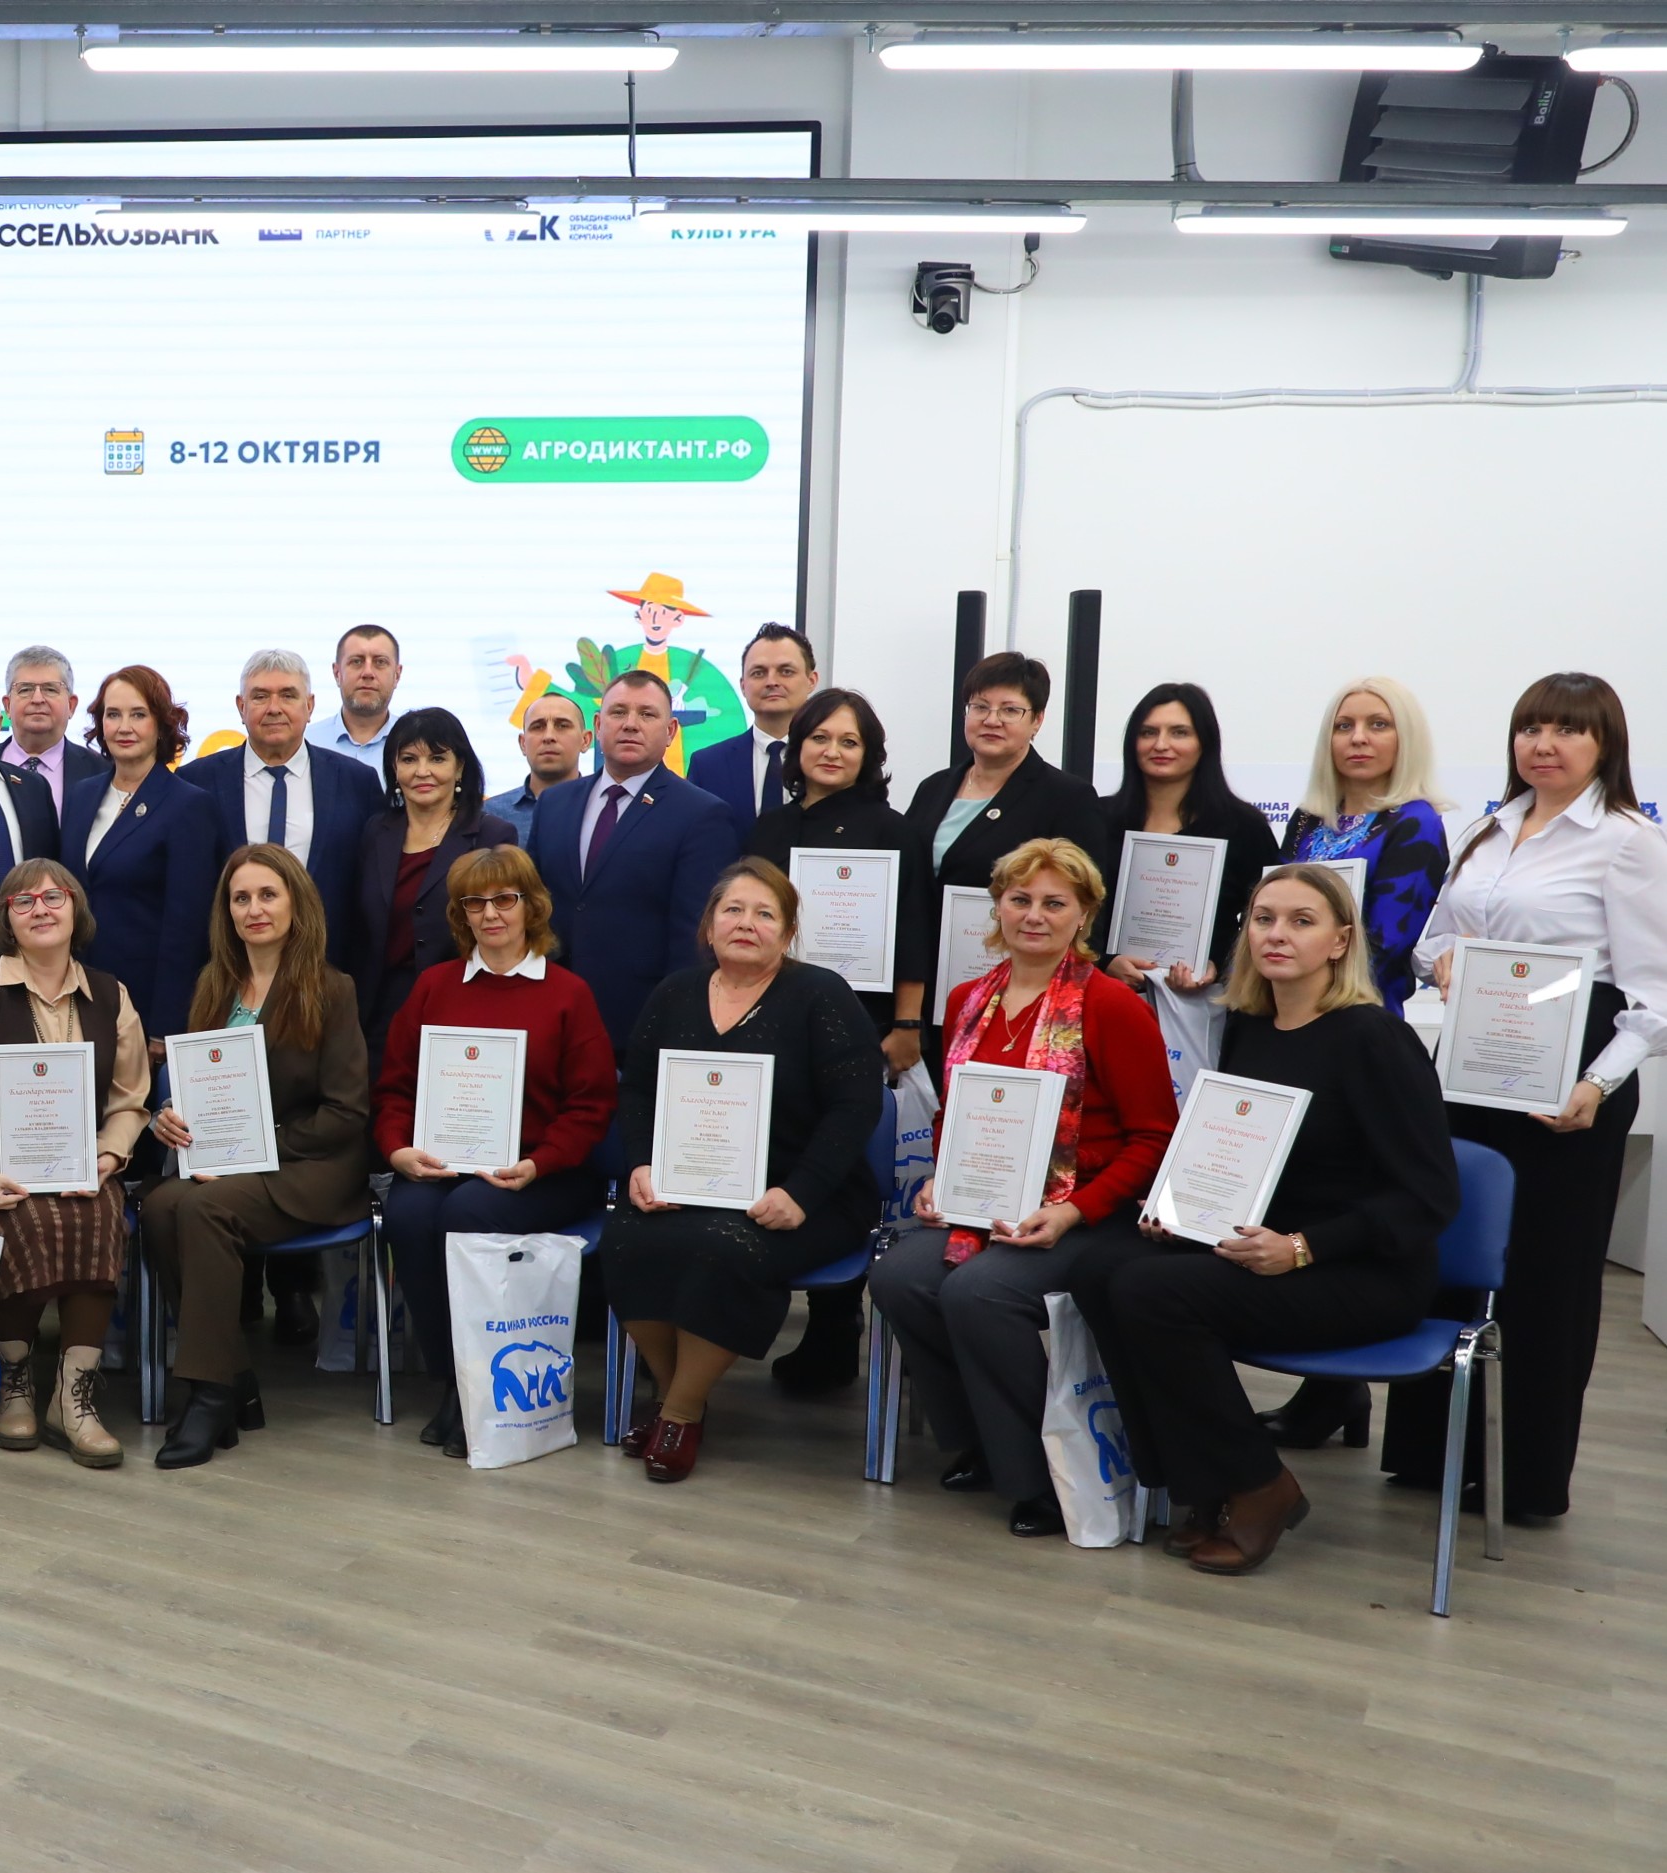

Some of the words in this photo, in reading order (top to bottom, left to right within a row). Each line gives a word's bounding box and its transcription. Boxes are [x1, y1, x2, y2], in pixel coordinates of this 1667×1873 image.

[316, 229, 371, 239] ПАРТНЕР
[169, 441, 230, 464] 8-12
[237, 440, 382, 464] ОКТЯБРЯ
[522, 438, 752, 464] АГРОДИКТАНТ.РФ
[486, 1318, 526, 1333] ЕДИНАЯ
[529, 1315, 569, 1328] РОССИЯ
